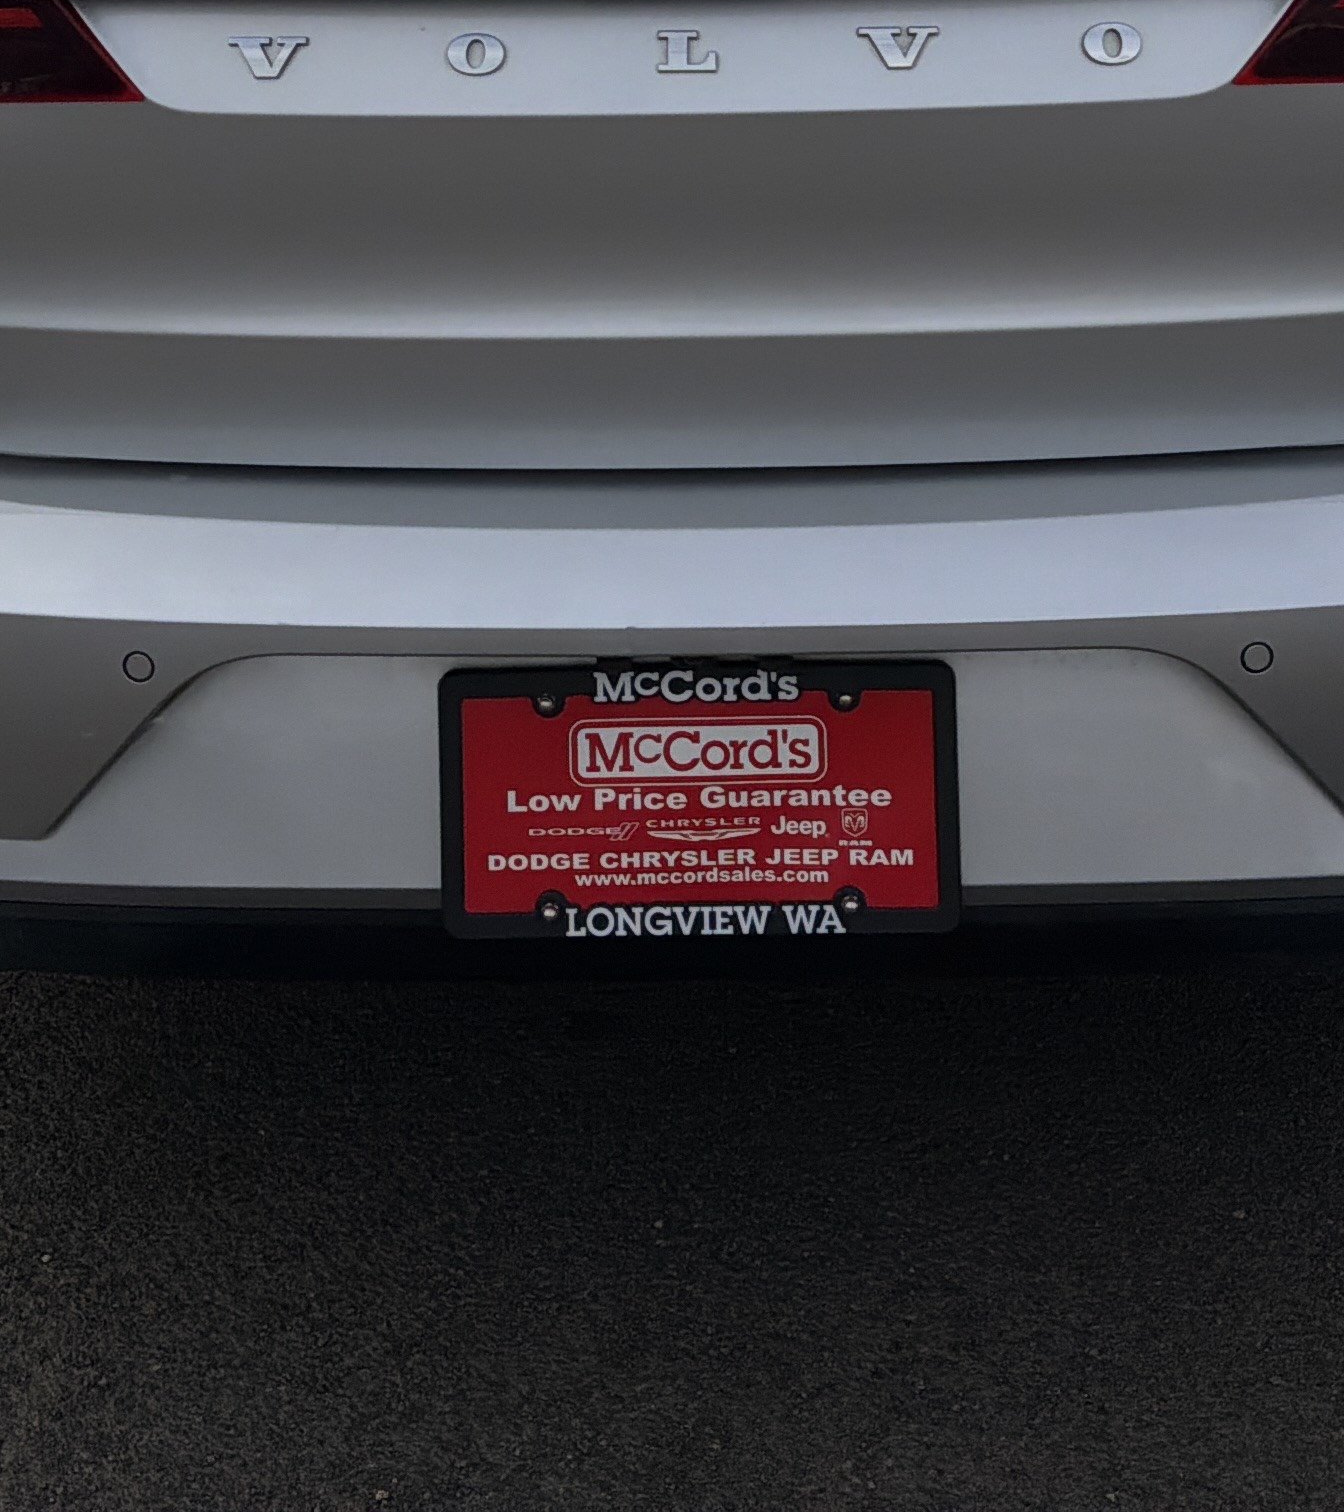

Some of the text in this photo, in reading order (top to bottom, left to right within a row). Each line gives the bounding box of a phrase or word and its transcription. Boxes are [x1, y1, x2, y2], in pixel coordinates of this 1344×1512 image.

[228, 21, 1143, 80] VOLVO
[592, 668, 800, 703] McCord's
[584, 728, 813, 773] McCord's
[506, 784, 893, 813] Low Price Guarantee
[528, 827, 622, 836] DODGE
[645, 816, 761, 828] CHRYSLER
[770, 815, 827, 838] Jeep
[487, 848, 915, 871] DODGE CHRYSLER JEEP RAM
[574, 865, 830, 887] www.mccordsales.com
[564, 903, 847, 938] LONGVIEW WA
